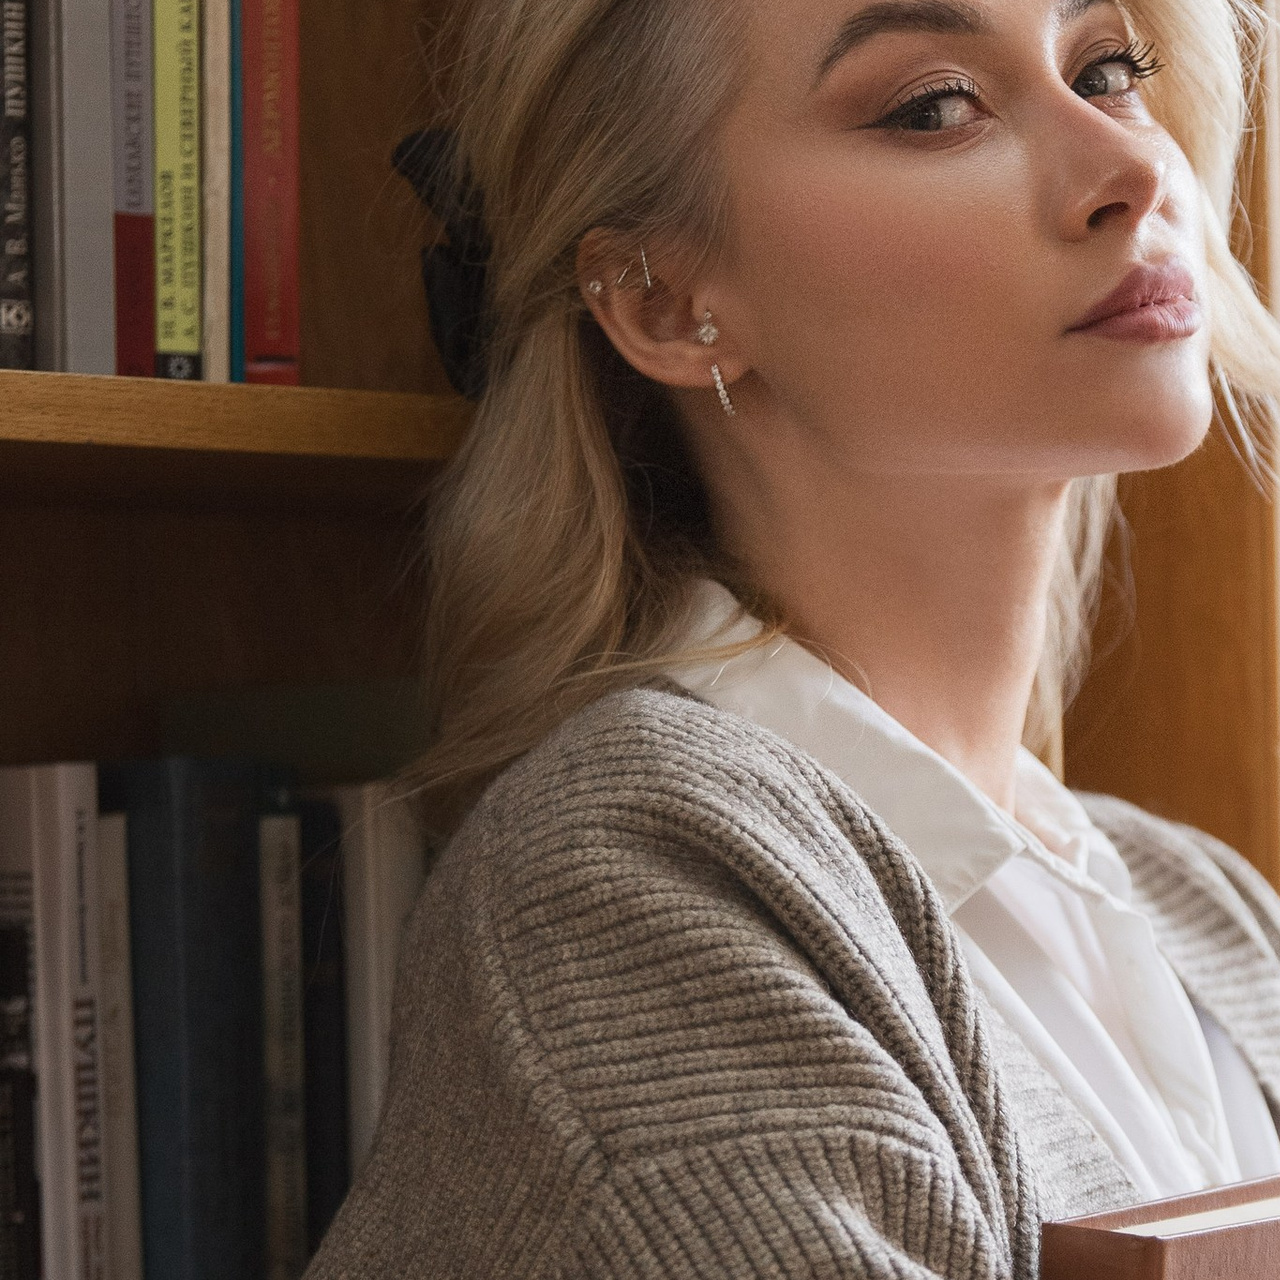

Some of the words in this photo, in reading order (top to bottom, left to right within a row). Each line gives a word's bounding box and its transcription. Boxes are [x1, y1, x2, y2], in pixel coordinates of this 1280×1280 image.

[2, 2, 28, 117] ПУШКИН
[176, 38, 196, 159] СЕВЕРНЫЙ
[179, 186, 196, 289] ПУШКИН
[73, 998, 102, 1204] ПУШКИН
